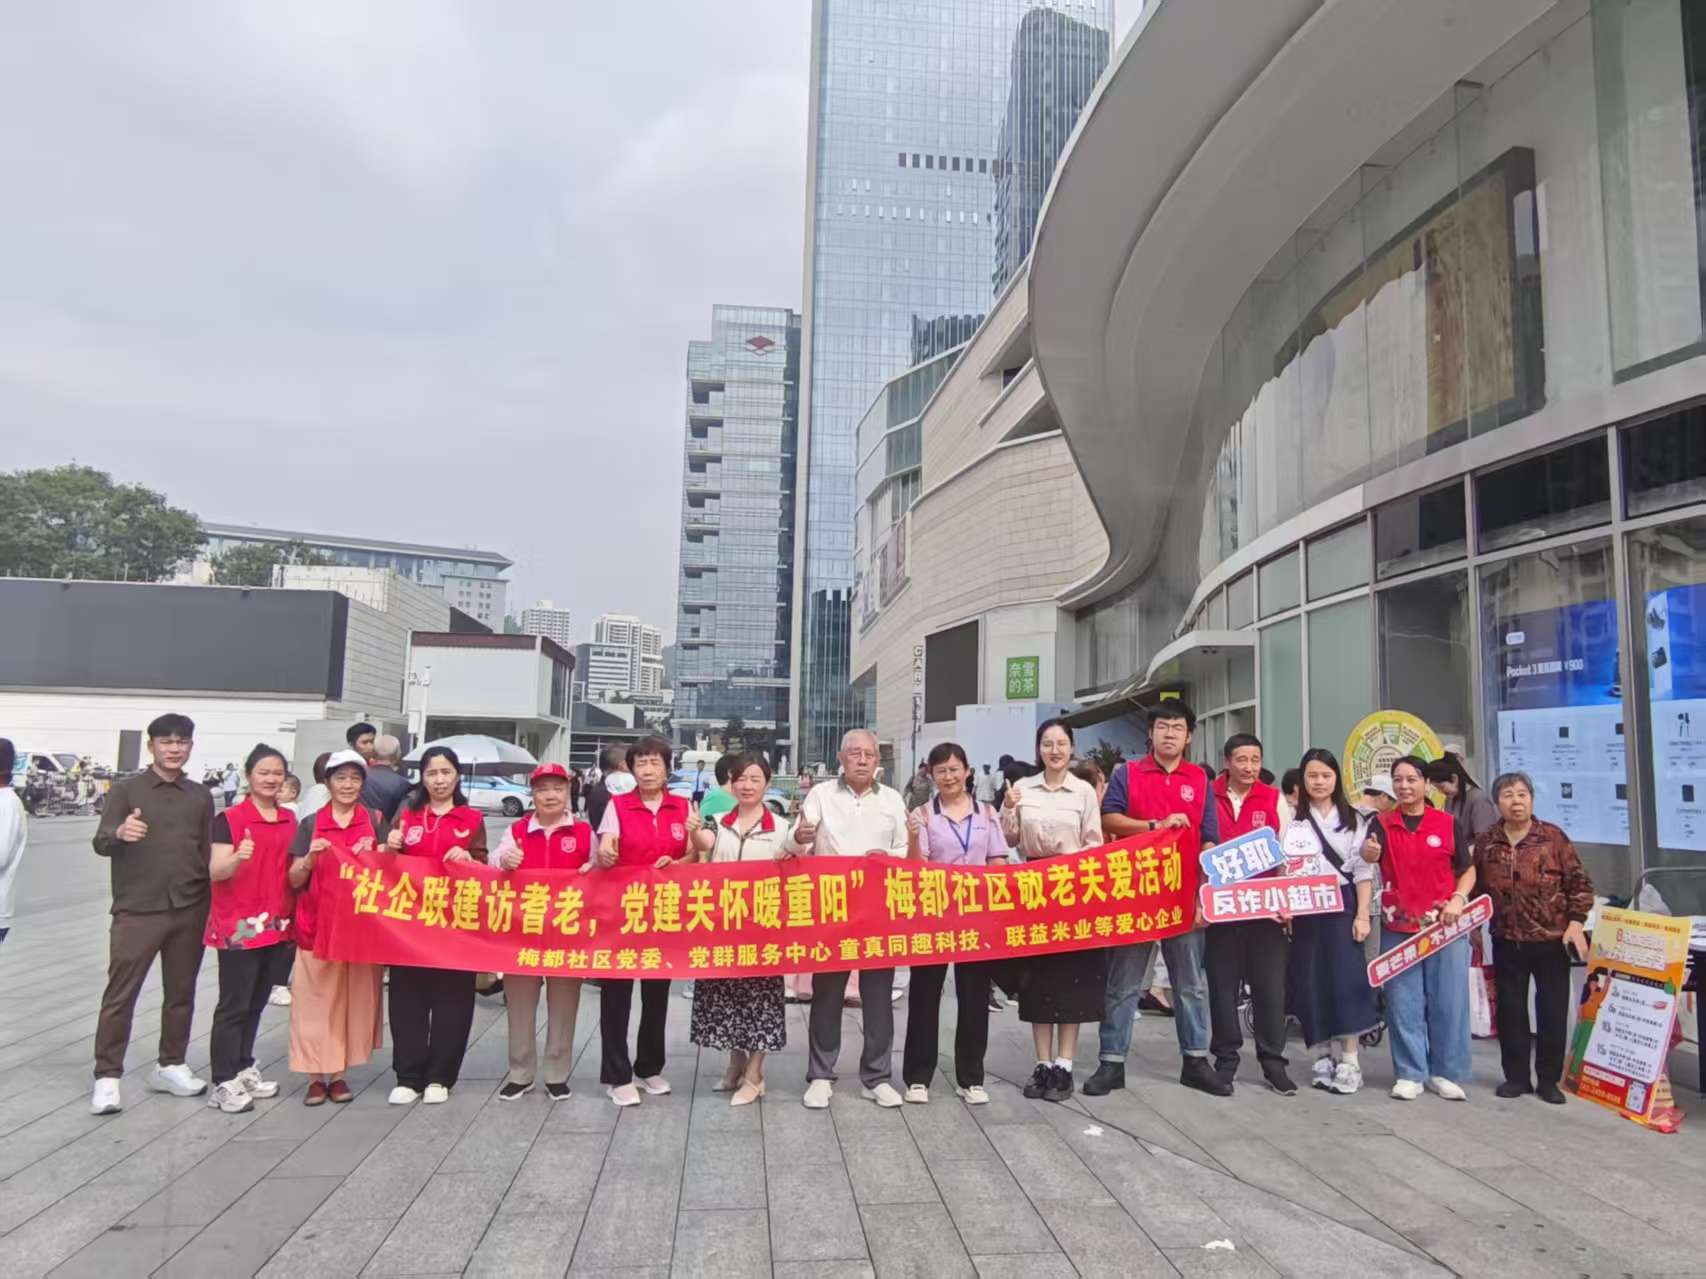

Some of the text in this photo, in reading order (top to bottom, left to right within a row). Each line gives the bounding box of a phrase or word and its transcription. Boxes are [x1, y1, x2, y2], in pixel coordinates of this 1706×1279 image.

[1211, 837, 1276, 884] 好耶
[1212, 882, 1338, 917] 反诈小超市
